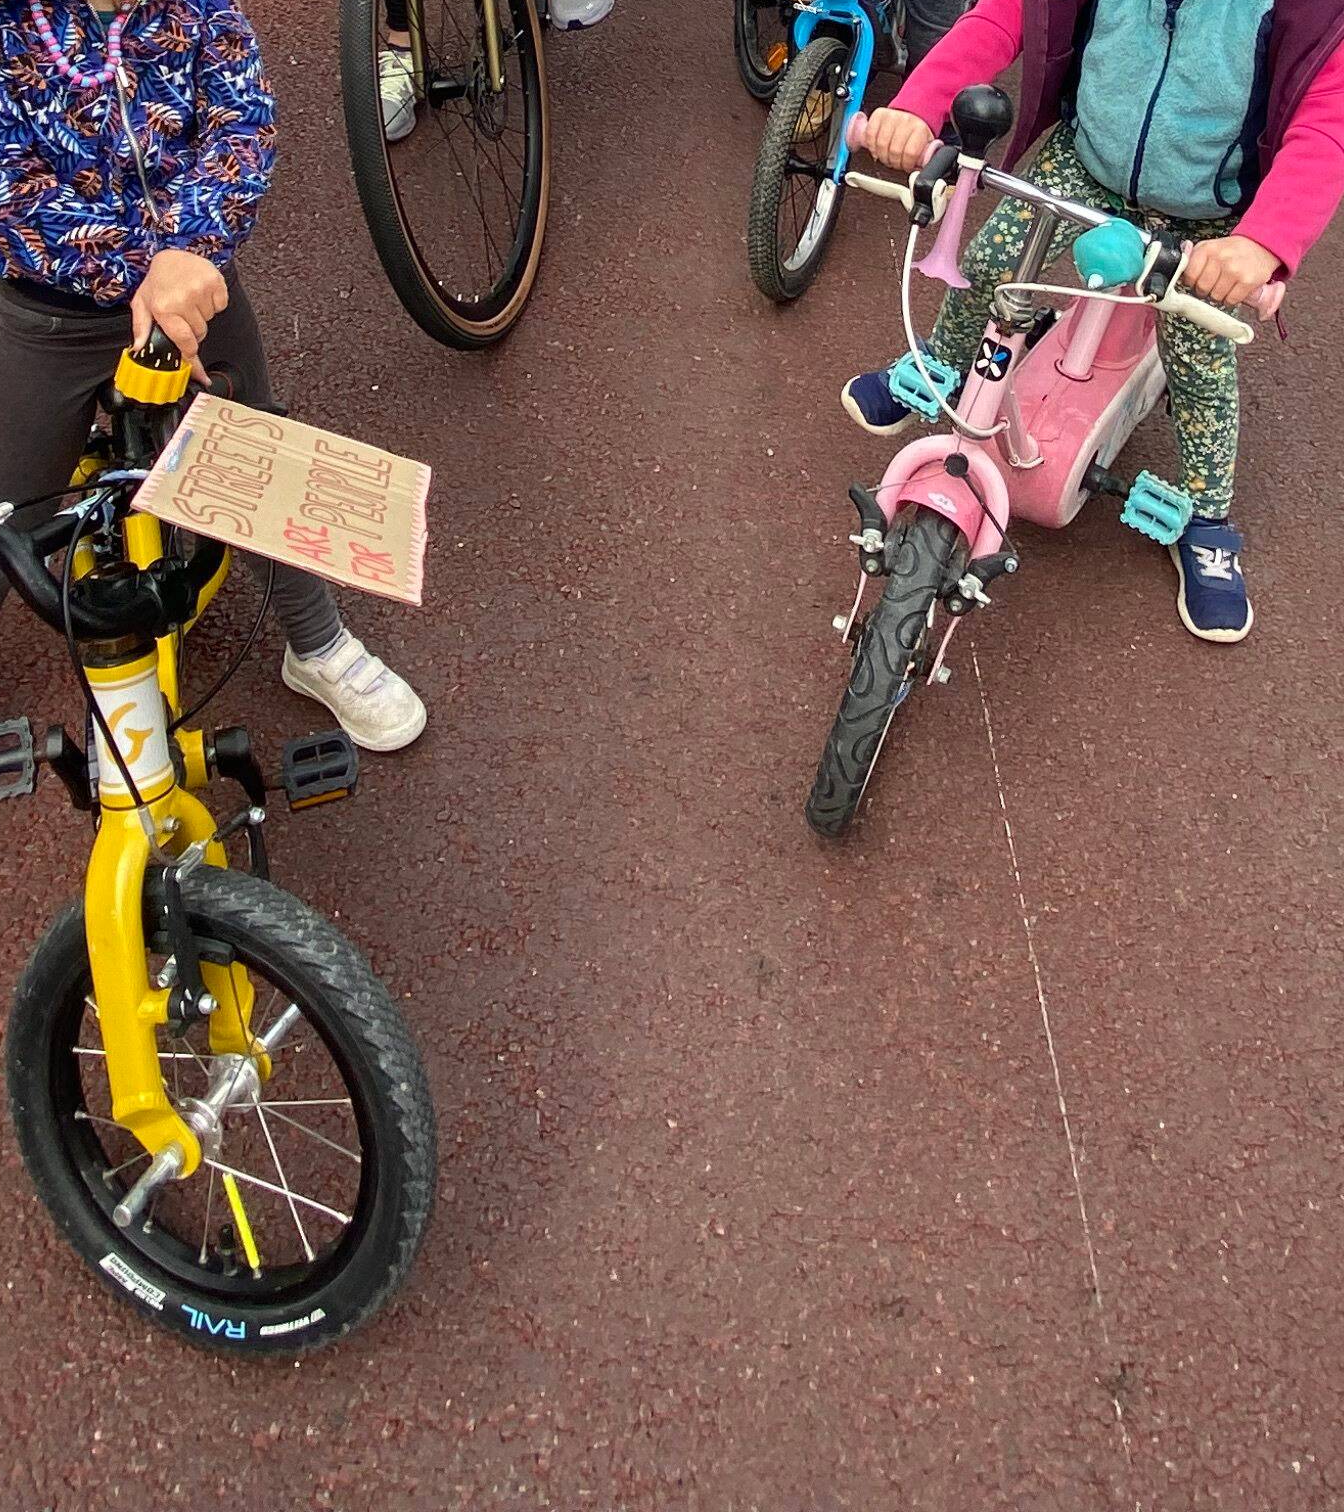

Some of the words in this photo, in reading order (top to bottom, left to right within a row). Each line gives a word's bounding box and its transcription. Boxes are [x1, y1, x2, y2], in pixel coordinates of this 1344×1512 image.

[172, 406, 284, 538] STREETS
[299, 439, 393, 542] PEOPLE
[283, 517, 336, 568] ARE
[347, 540, 400, 588] FOR
[180, 1303, 246, 1339] RAIL
